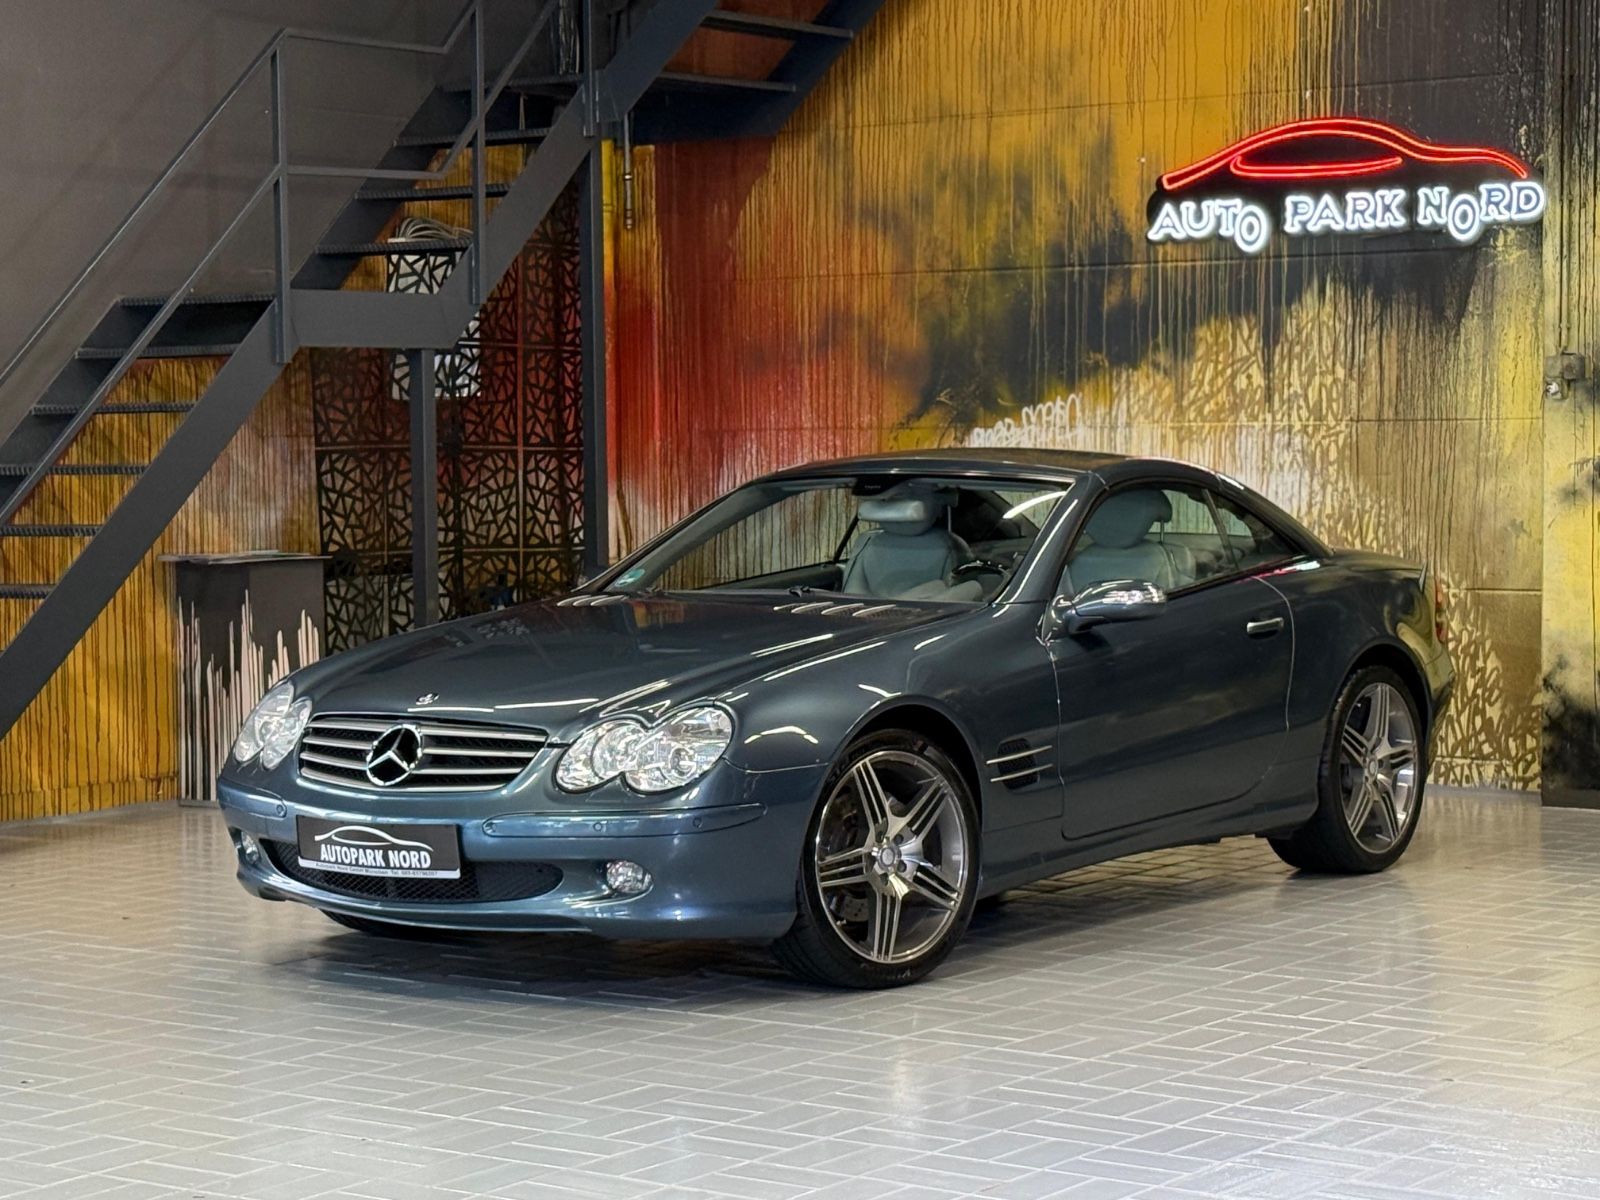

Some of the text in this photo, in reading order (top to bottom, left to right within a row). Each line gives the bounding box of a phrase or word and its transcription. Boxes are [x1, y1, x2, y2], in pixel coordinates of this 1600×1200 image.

[1147, 181, 1545, 253] AUTO PARK NORD
[320, 844, 431, 869] AUTOPARK NORD
